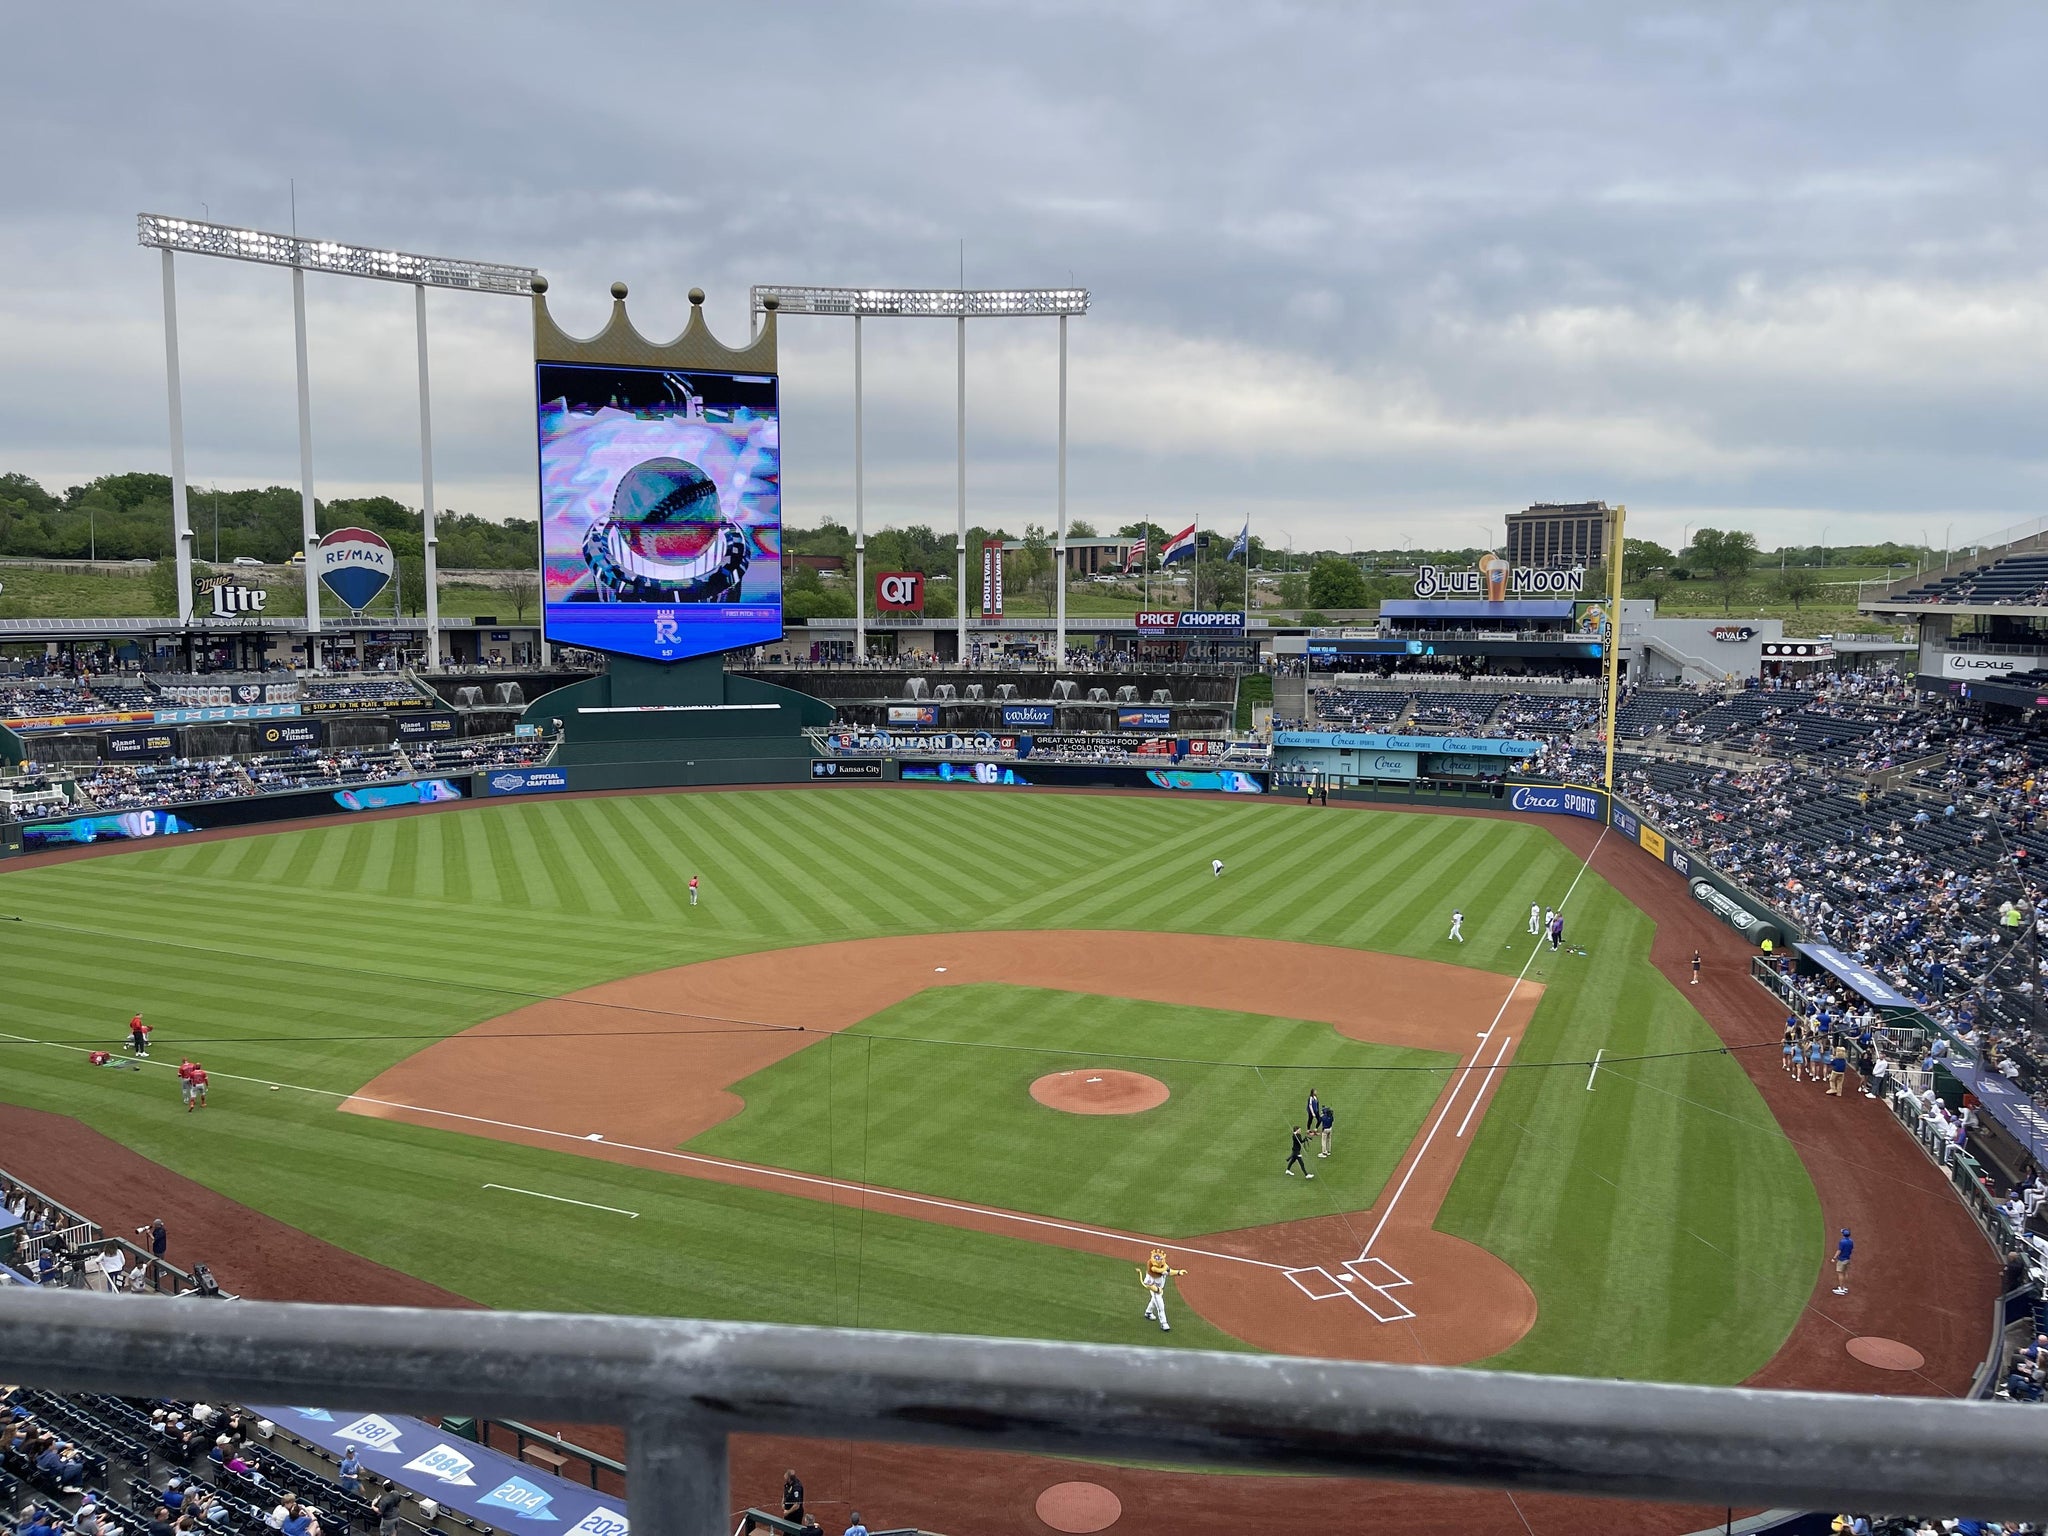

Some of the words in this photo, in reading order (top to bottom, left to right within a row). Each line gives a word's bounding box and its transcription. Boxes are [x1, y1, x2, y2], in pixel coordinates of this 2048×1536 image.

[326, 550, 384, 565] RE/MAX
[195, 573, 233, 594] Miller
[983, 552, 991, 609] BOULEVARD
[1414, 565, 1479, 597] BLUE
[1512, 568, 1584, 592] MOON
[881, 576, 916, 604] QT
[211, 584, 267, 618] Lite
[1140, 614, 1175, 625] PRICE
[1182, 614, 1241, 625] CHOPPER
[1717, 631, 1748, 639] RIVALS
[1967, 661, 2014, 670] LEXUS
[1005, 708, 1050, 723] carbliss
[282, 727, 308, 737] planet
[401, 721, 421, 731] planet
[285, 733, 313, 741] fitness
[859, 737, 946, 749] FOUNTAIN
[952, 737, 996, 749] DECK
[1037, 736, 1062, 744] GREAT
[1063, 737, 1086, 745] VIEWS
[1091, 738, 1116, 746] FRESH
[1277, 732, 1301, 744] Circa
[1331, 734, 1356, 746] Circa
[1387, 736, 1410, 748] Circa
[112, 739, 136, 750] planet
[115, 744, 140, 752] fitness
[1001, 740, 1013, 749] QT
[1056, 744, 1092, 752] ICE-COLD
[1191, 742, 1205, 753] QT
[1442, 738, 1467, 751] Circa
[1500, 741, 1525, 754] Circa
[1291, 756, 1309, 766] Circa
[1374, 755, 1401, 770] Circa
[1441, 756, 1473, 771] Circa
[839, 765, 865, 773] Kansas
[866, 765, 880, 775] City
[530, 773, 560, 781] OFFICIAL
[1512, 787, 1560, 810] Circa
[1564, 794, 1595, 814] SPORTS
[351, 1421, 392, 1442] 1981
[419, 1451, 468, 1477] 1984
[492, 1483, 544, 1509] 2014
